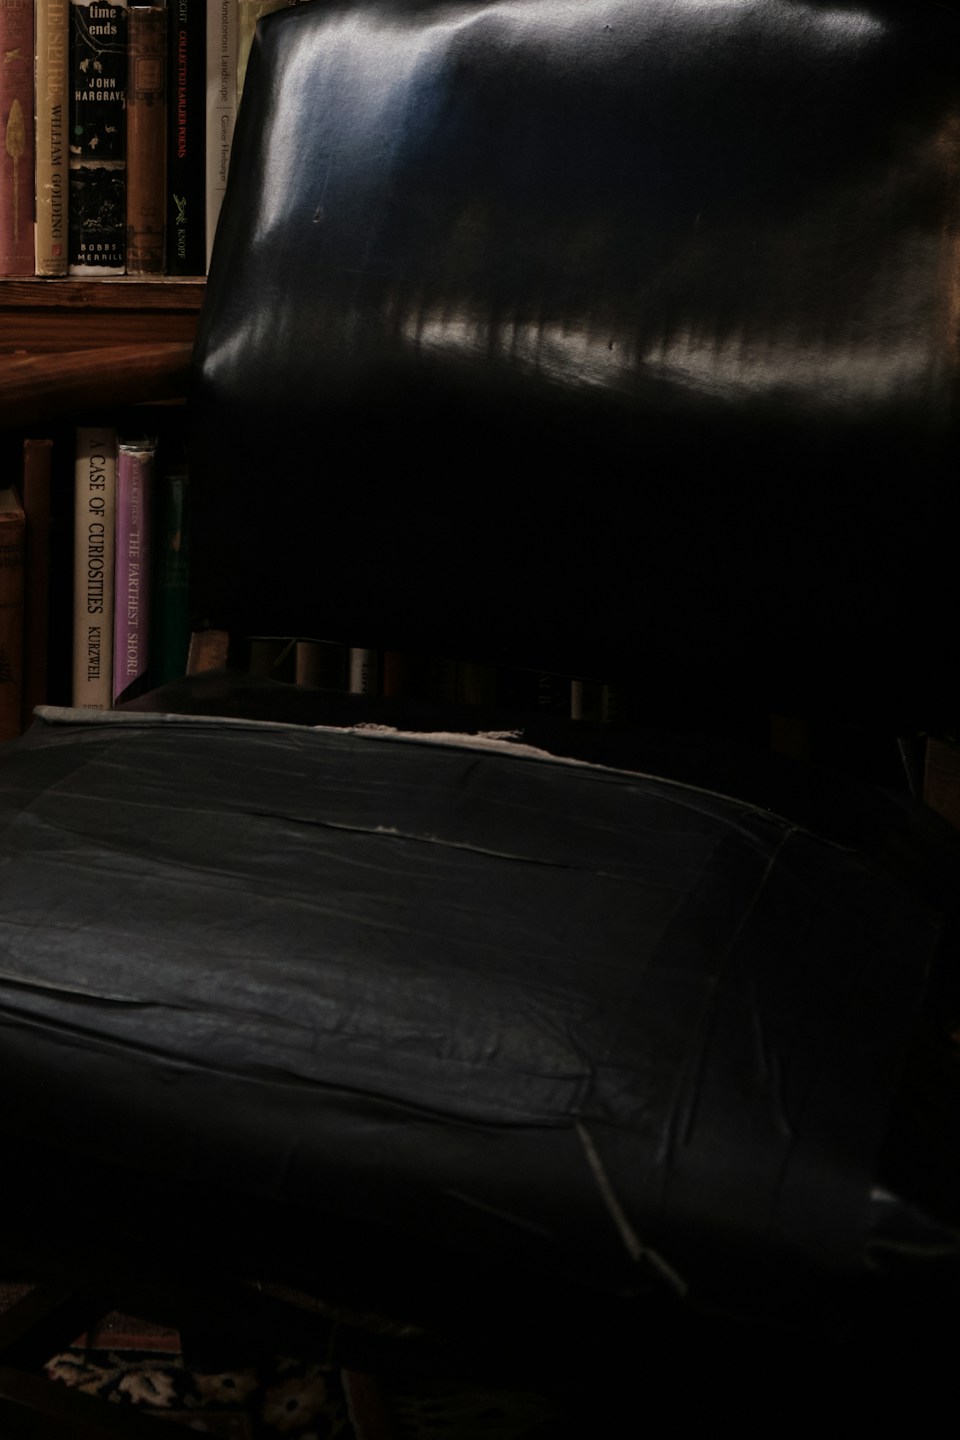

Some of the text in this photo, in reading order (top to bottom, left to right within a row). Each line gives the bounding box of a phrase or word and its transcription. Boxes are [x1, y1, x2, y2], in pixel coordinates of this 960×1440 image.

[90, 7, 116, 19] time
[89, 23, 117, 35] ends
[89, 78, 115, 88] JOHN
[75, 91, 124, 101] HARGRAVE
[51, 104, 62, 239] WILLIAM GOLDING
[178, 229, 186, 258] KNOPF
[88, 455, 105, 681] CASE OF CURIOSITIES KURZWEIL
[127, 531, 139, 676] THE FARTHEST SHORE
